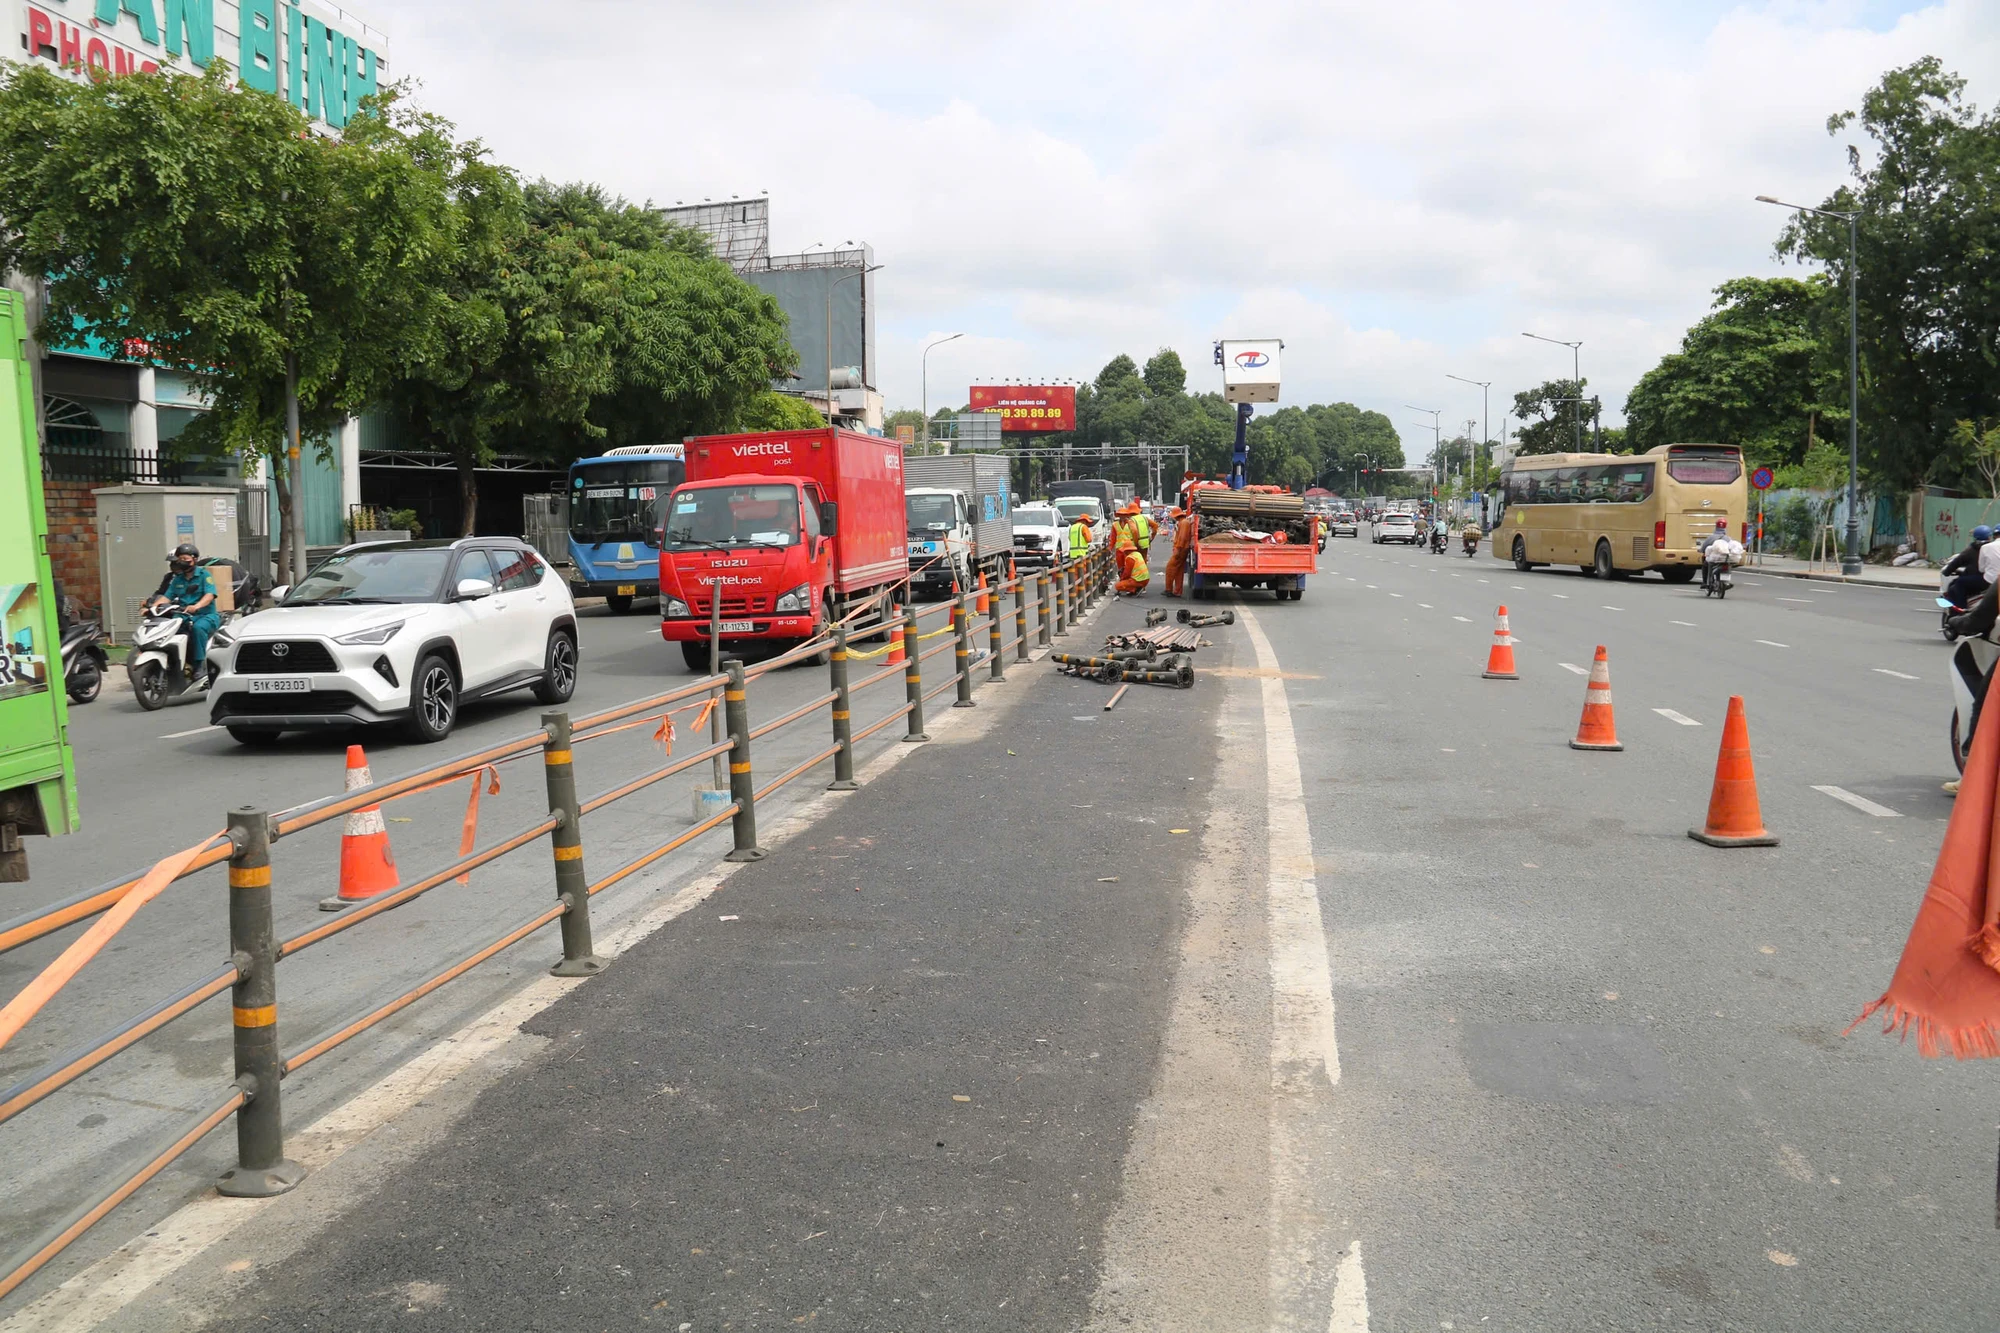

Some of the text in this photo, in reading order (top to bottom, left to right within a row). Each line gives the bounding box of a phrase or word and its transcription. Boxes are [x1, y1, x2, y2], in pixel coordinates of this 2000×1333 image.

[732, 442, 791, 456] viettel
[711, 559, 748, 568] ISUZU
[741, 576, 762, 586] post
[253, 681, 305, 691] 51K-823.03
